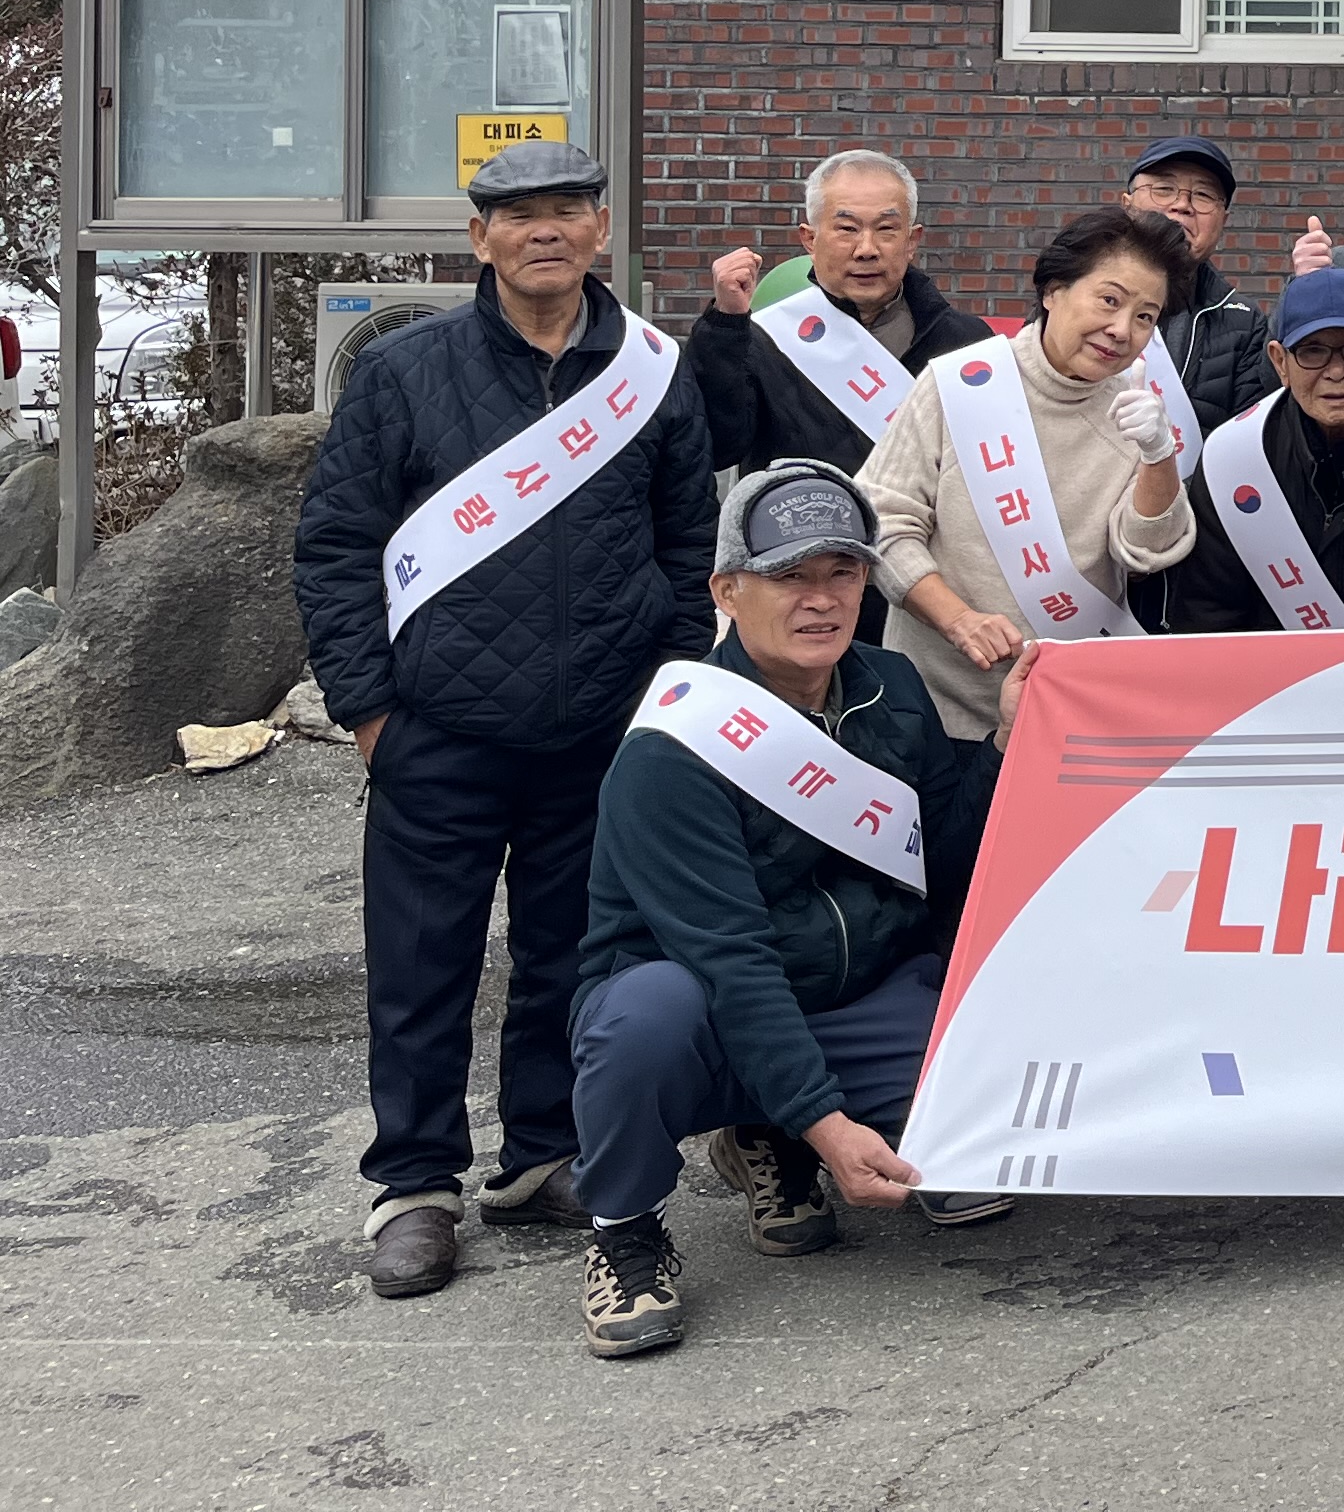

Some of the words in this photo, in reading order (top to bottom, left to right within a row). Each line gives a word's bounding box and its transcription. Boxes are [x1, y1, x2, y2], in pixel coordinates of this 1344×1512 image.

[483, 123, 542, 140] 대피소
[768, 494, 809, 516] CLASSIC
[979, 435, 1079, 622] 나라사랑
[717, 706, 893, 835] 태극기
